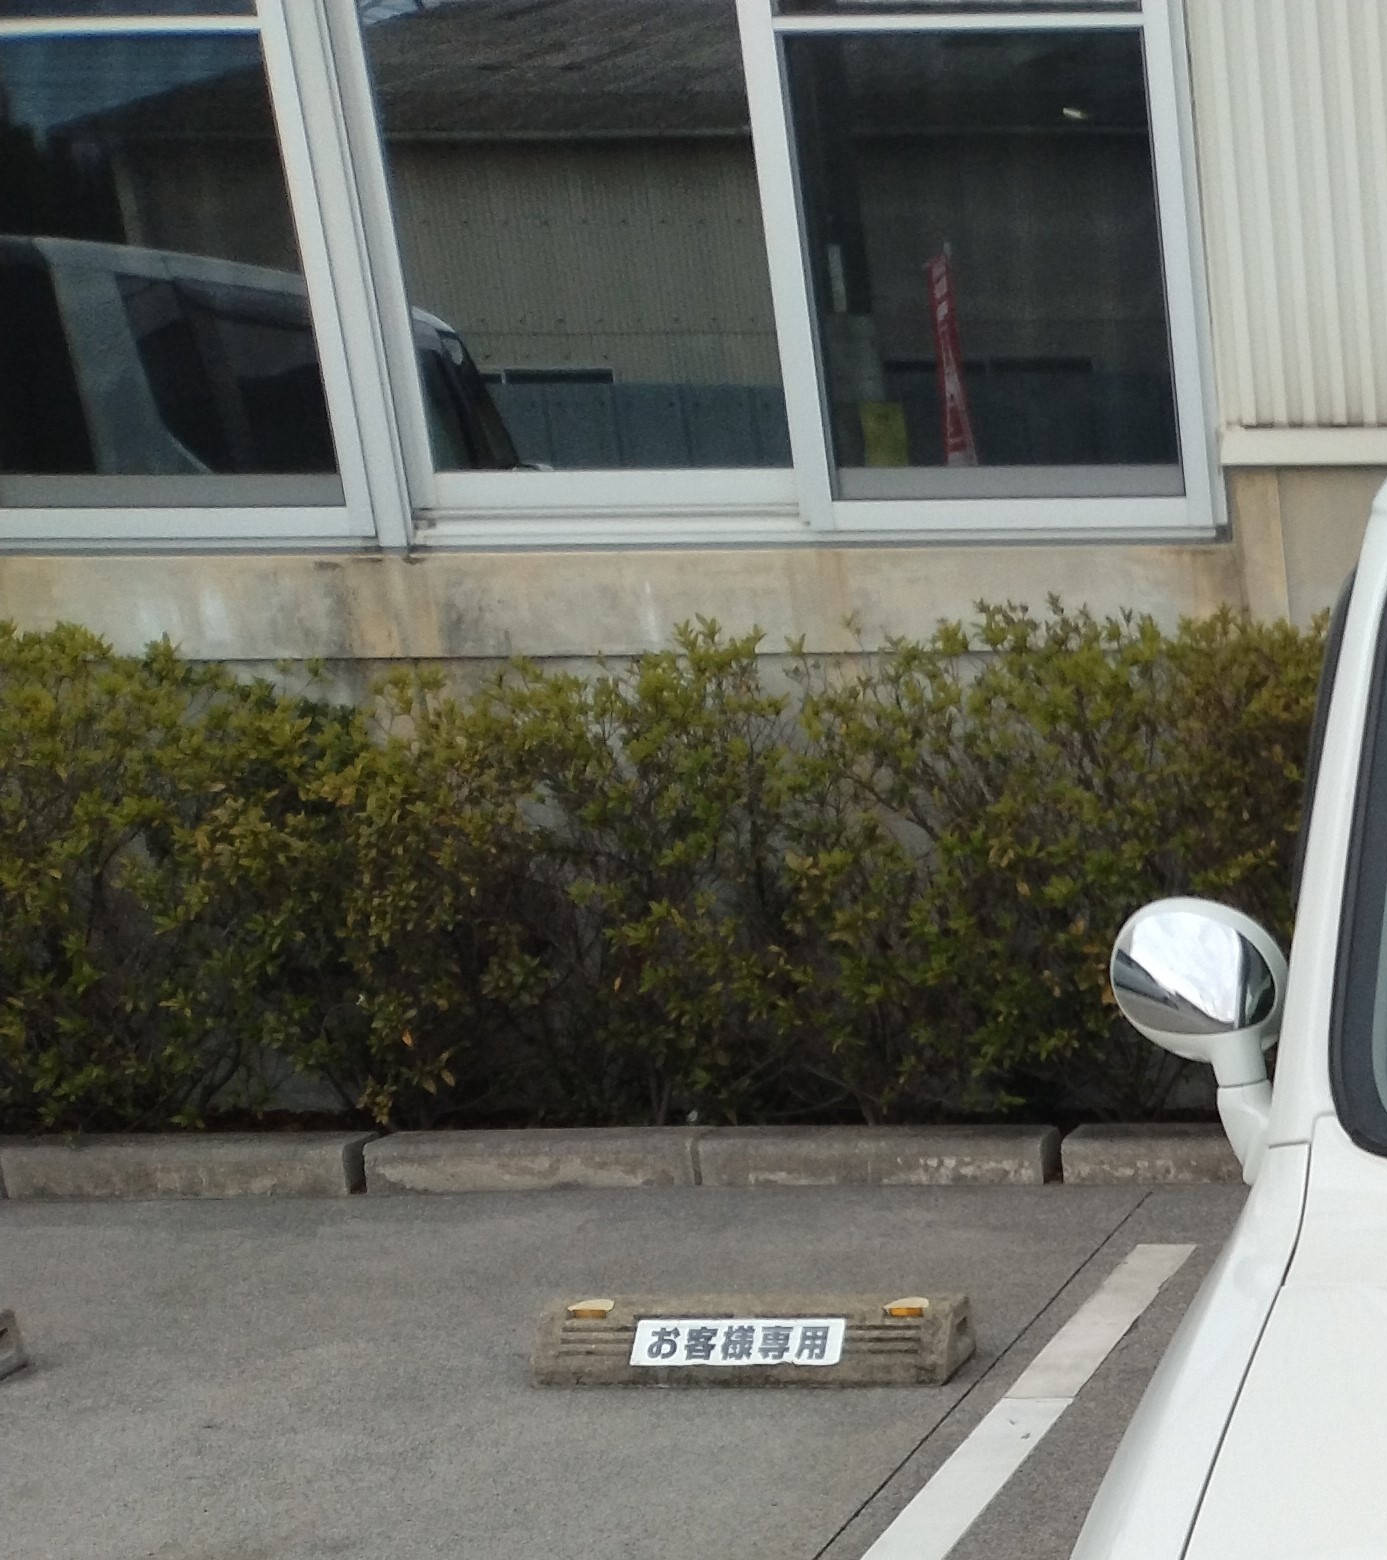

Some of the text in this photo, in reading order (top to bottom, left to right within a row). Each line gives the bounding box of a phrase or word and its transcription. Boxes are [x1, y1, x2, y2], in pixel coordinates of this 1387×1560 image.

[646, 1325, 830, 1361] お客様専用
